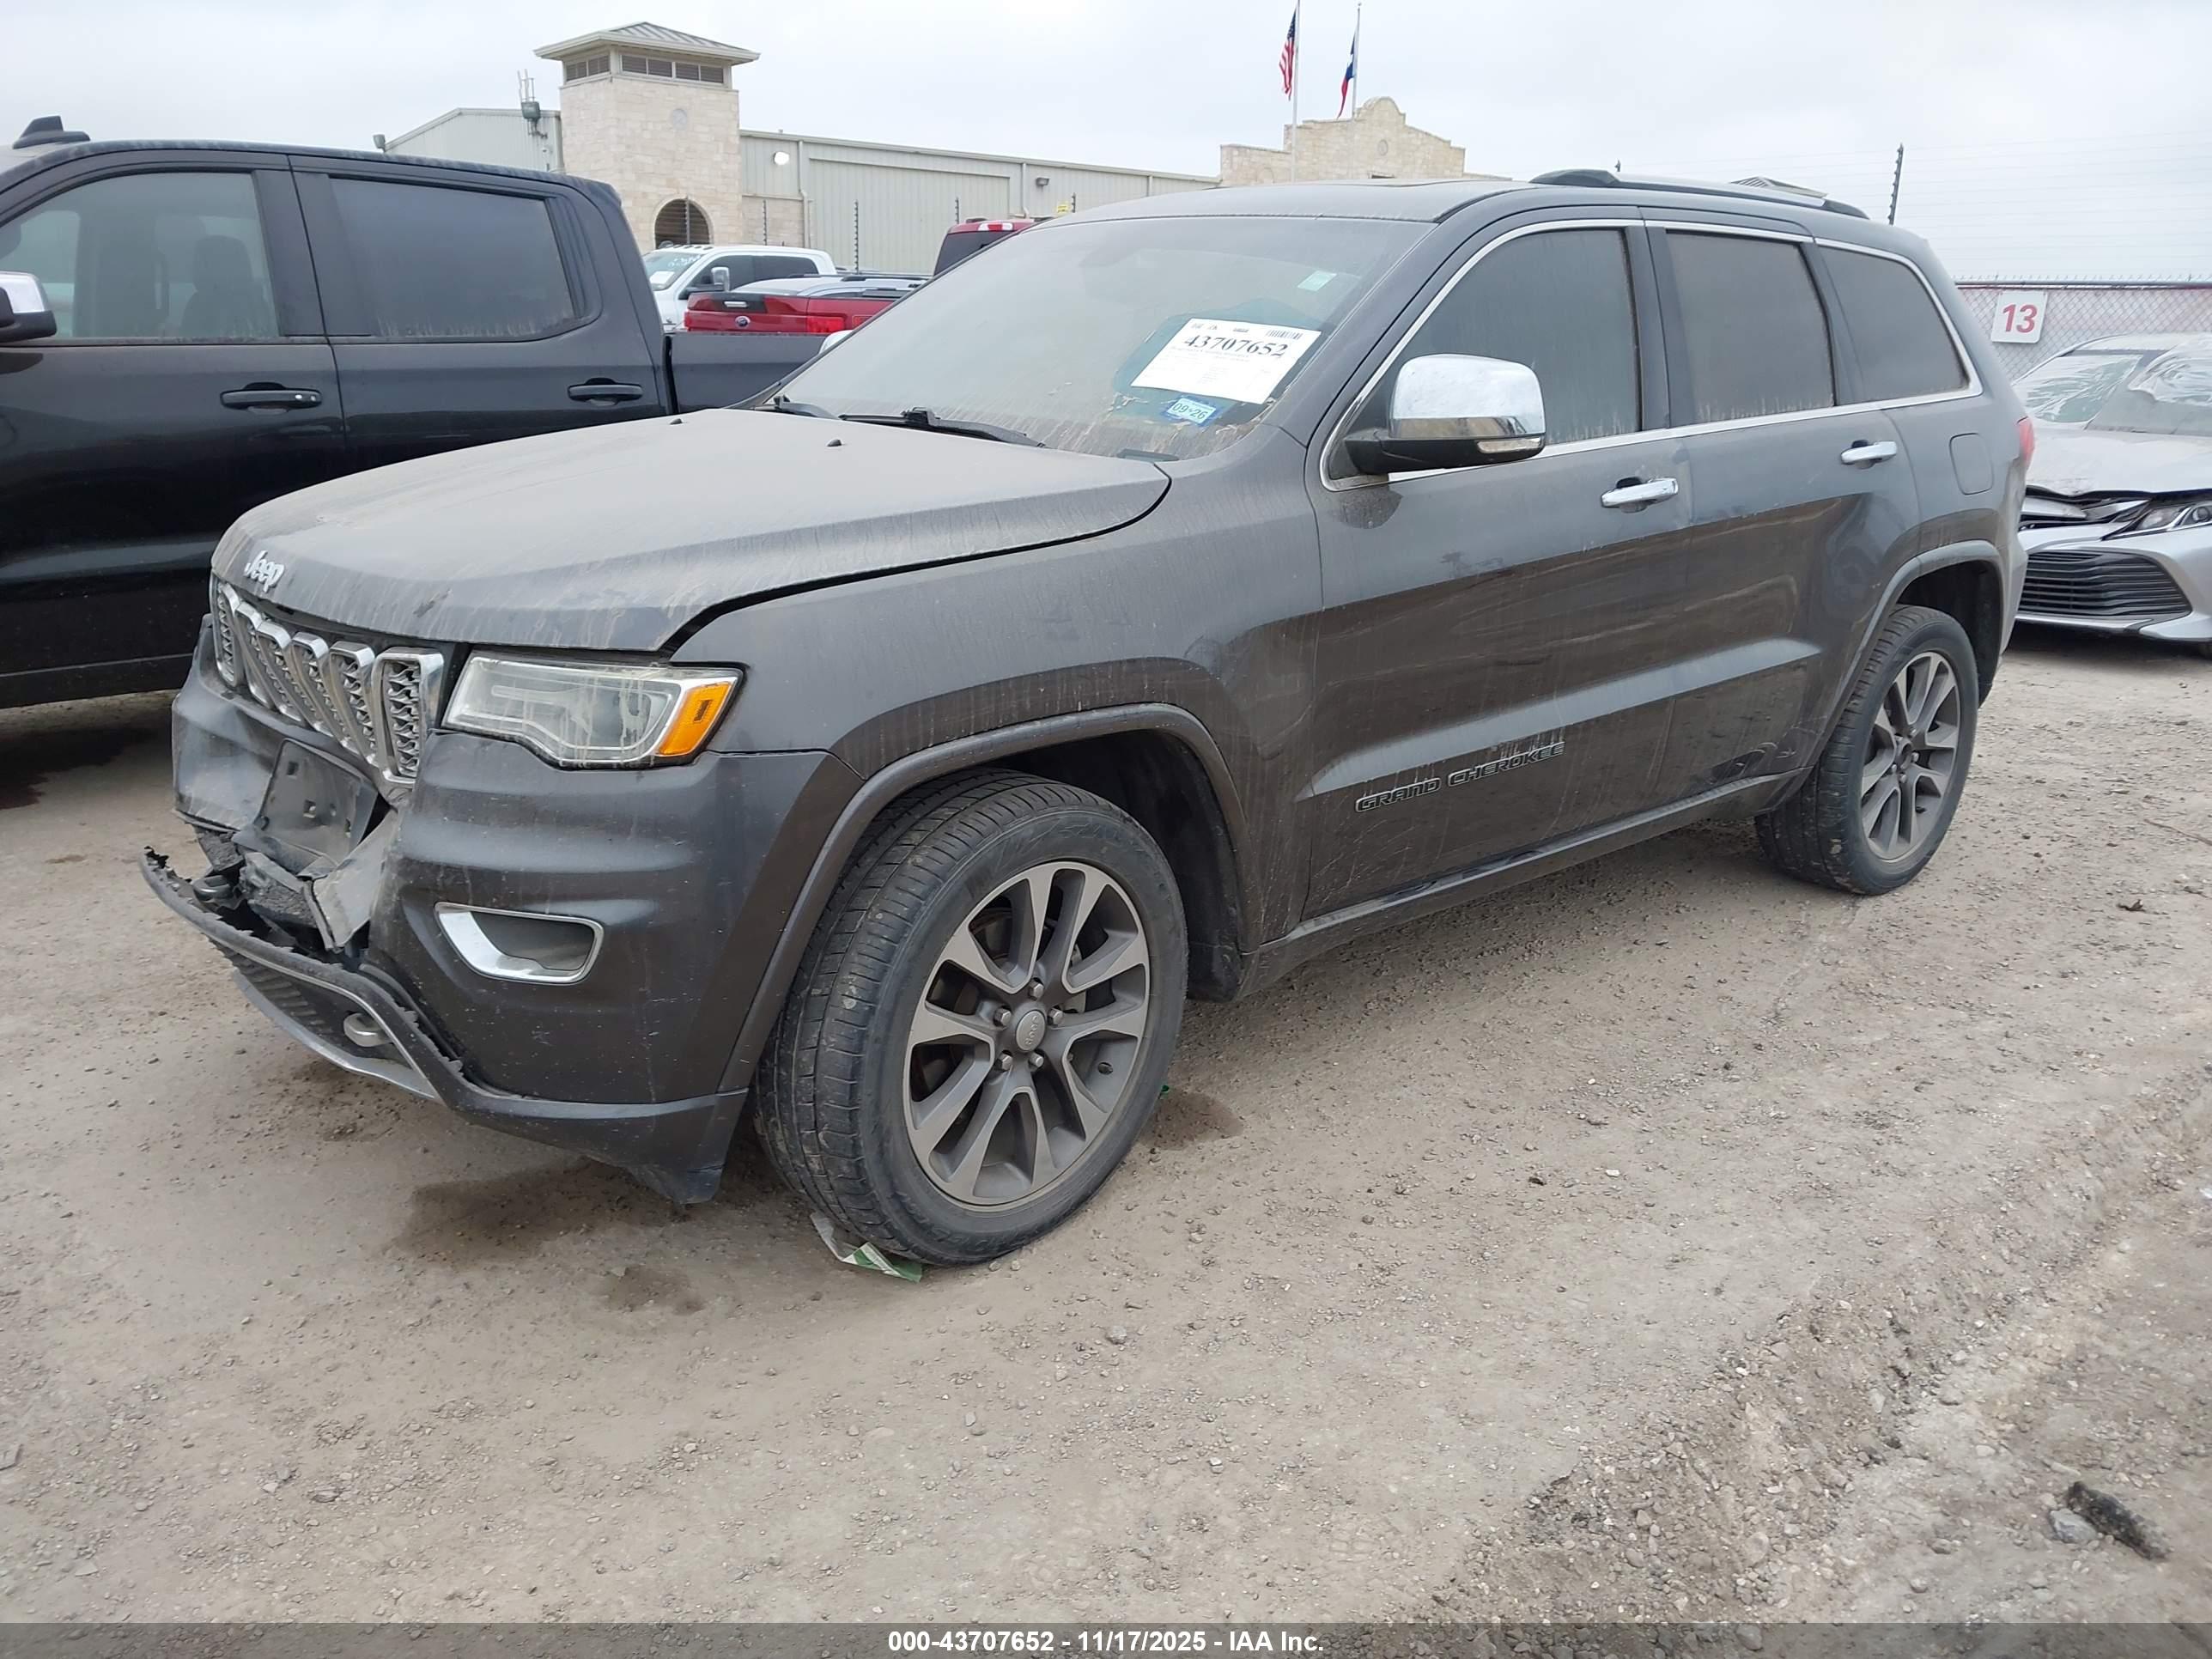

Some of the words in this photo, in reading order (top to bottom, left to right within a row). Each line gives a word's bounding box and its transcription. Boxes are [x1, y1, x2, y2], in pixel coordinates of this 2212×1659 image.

[2002, 303, 2039, 334] 13
[1184, 334, 1288, 357] 43707652
[1172, 403, 1189, 413] 09
[1190, 409, 1208, 420] 26
[244, 550, 285, 593] Jeep
[1354, 778, 1442, 812] GRAND
[1446, 741, 1566, 787] CHEROKEE
